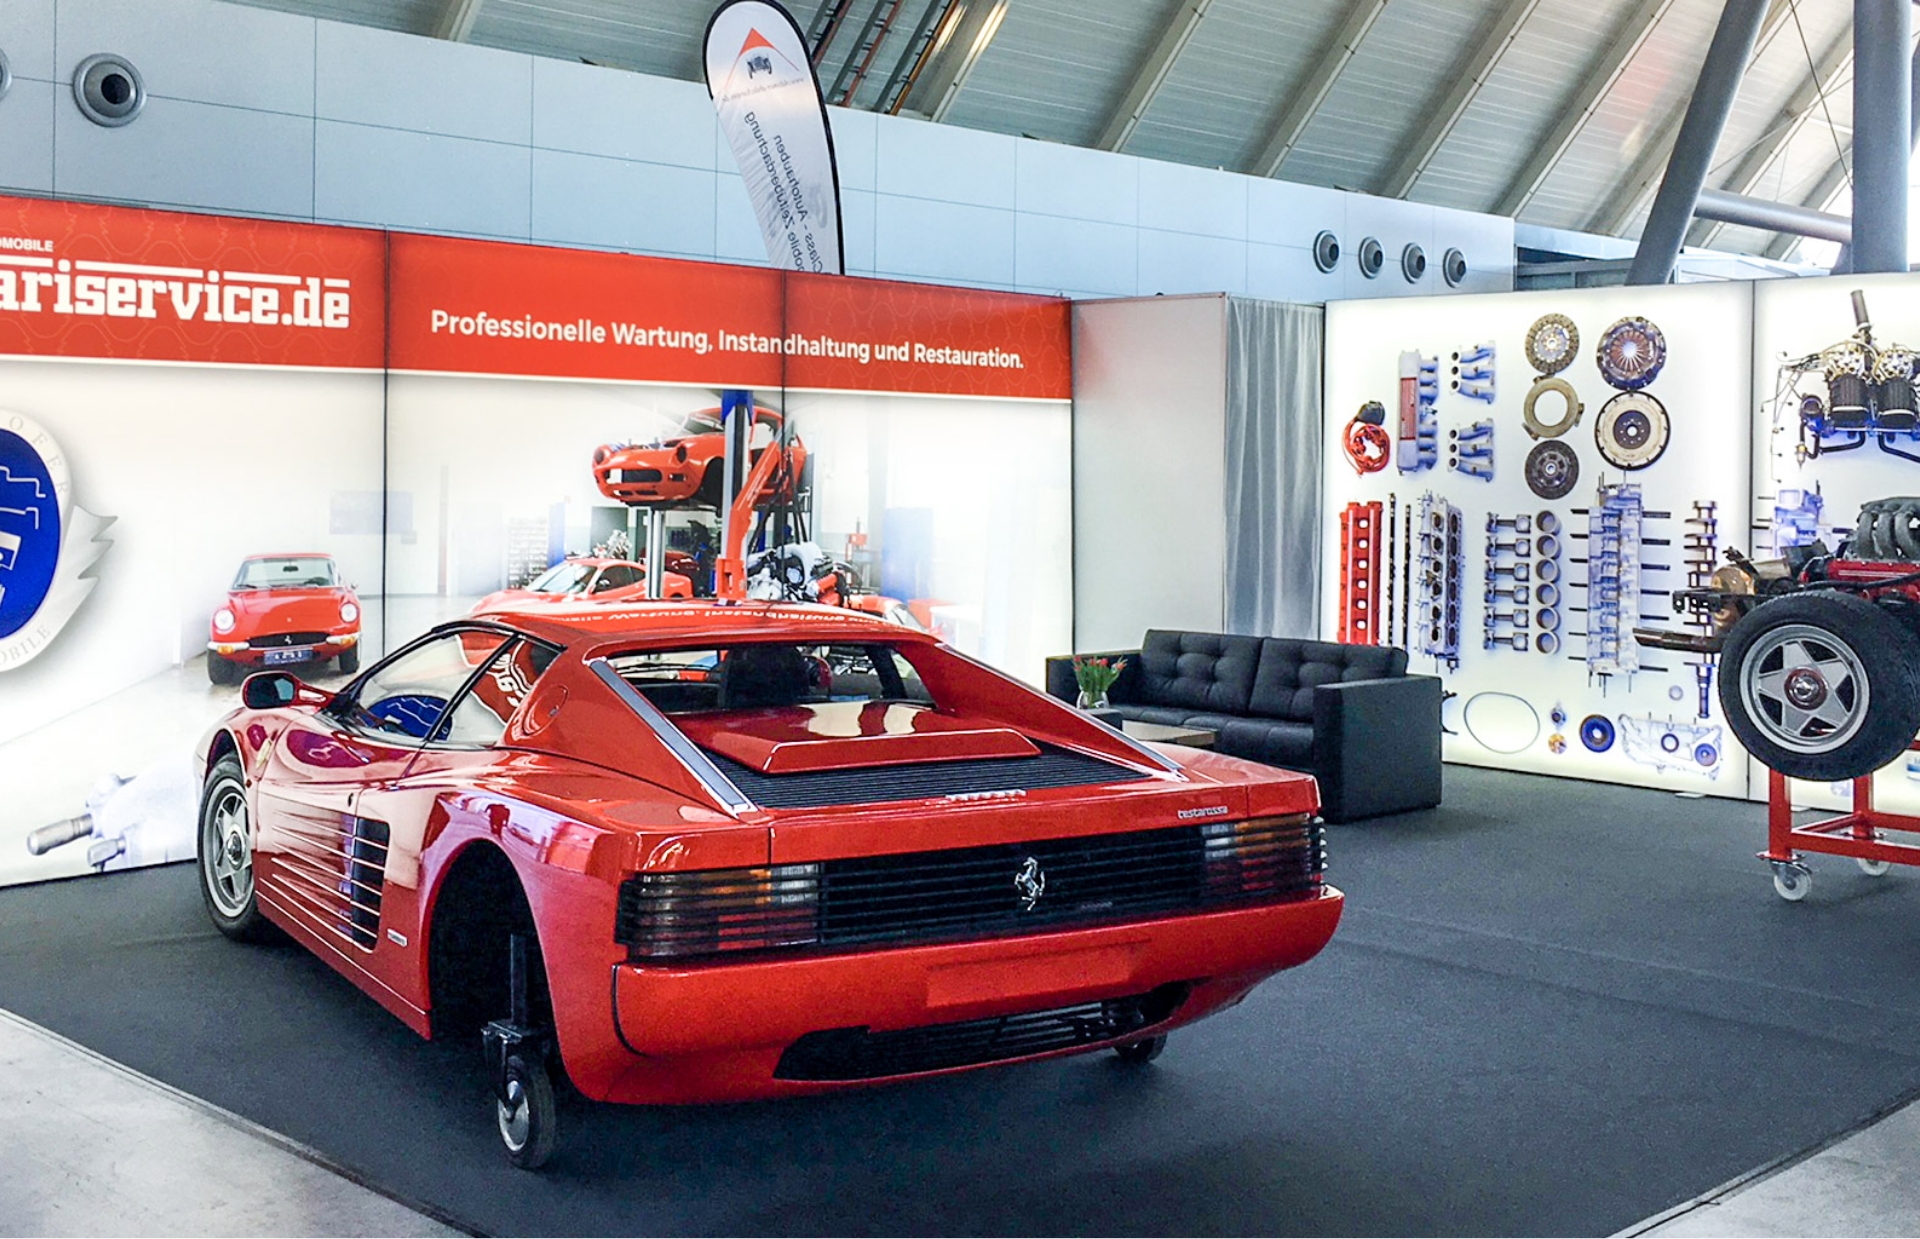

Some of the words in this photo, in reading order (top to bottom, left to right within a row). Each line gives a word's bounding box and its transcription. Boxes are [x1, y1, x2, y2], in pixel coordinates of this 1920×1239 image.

[0, 237, 54, 252] MOBILE
[431, 309, 606, 344] Professionelle
[611, 322, 713, 354] Wartung,
[718, 330, 870, 363] Instandhaltung
[874, 341, 909, 362] und
[913, 343, 1025, 369] Restauration.
